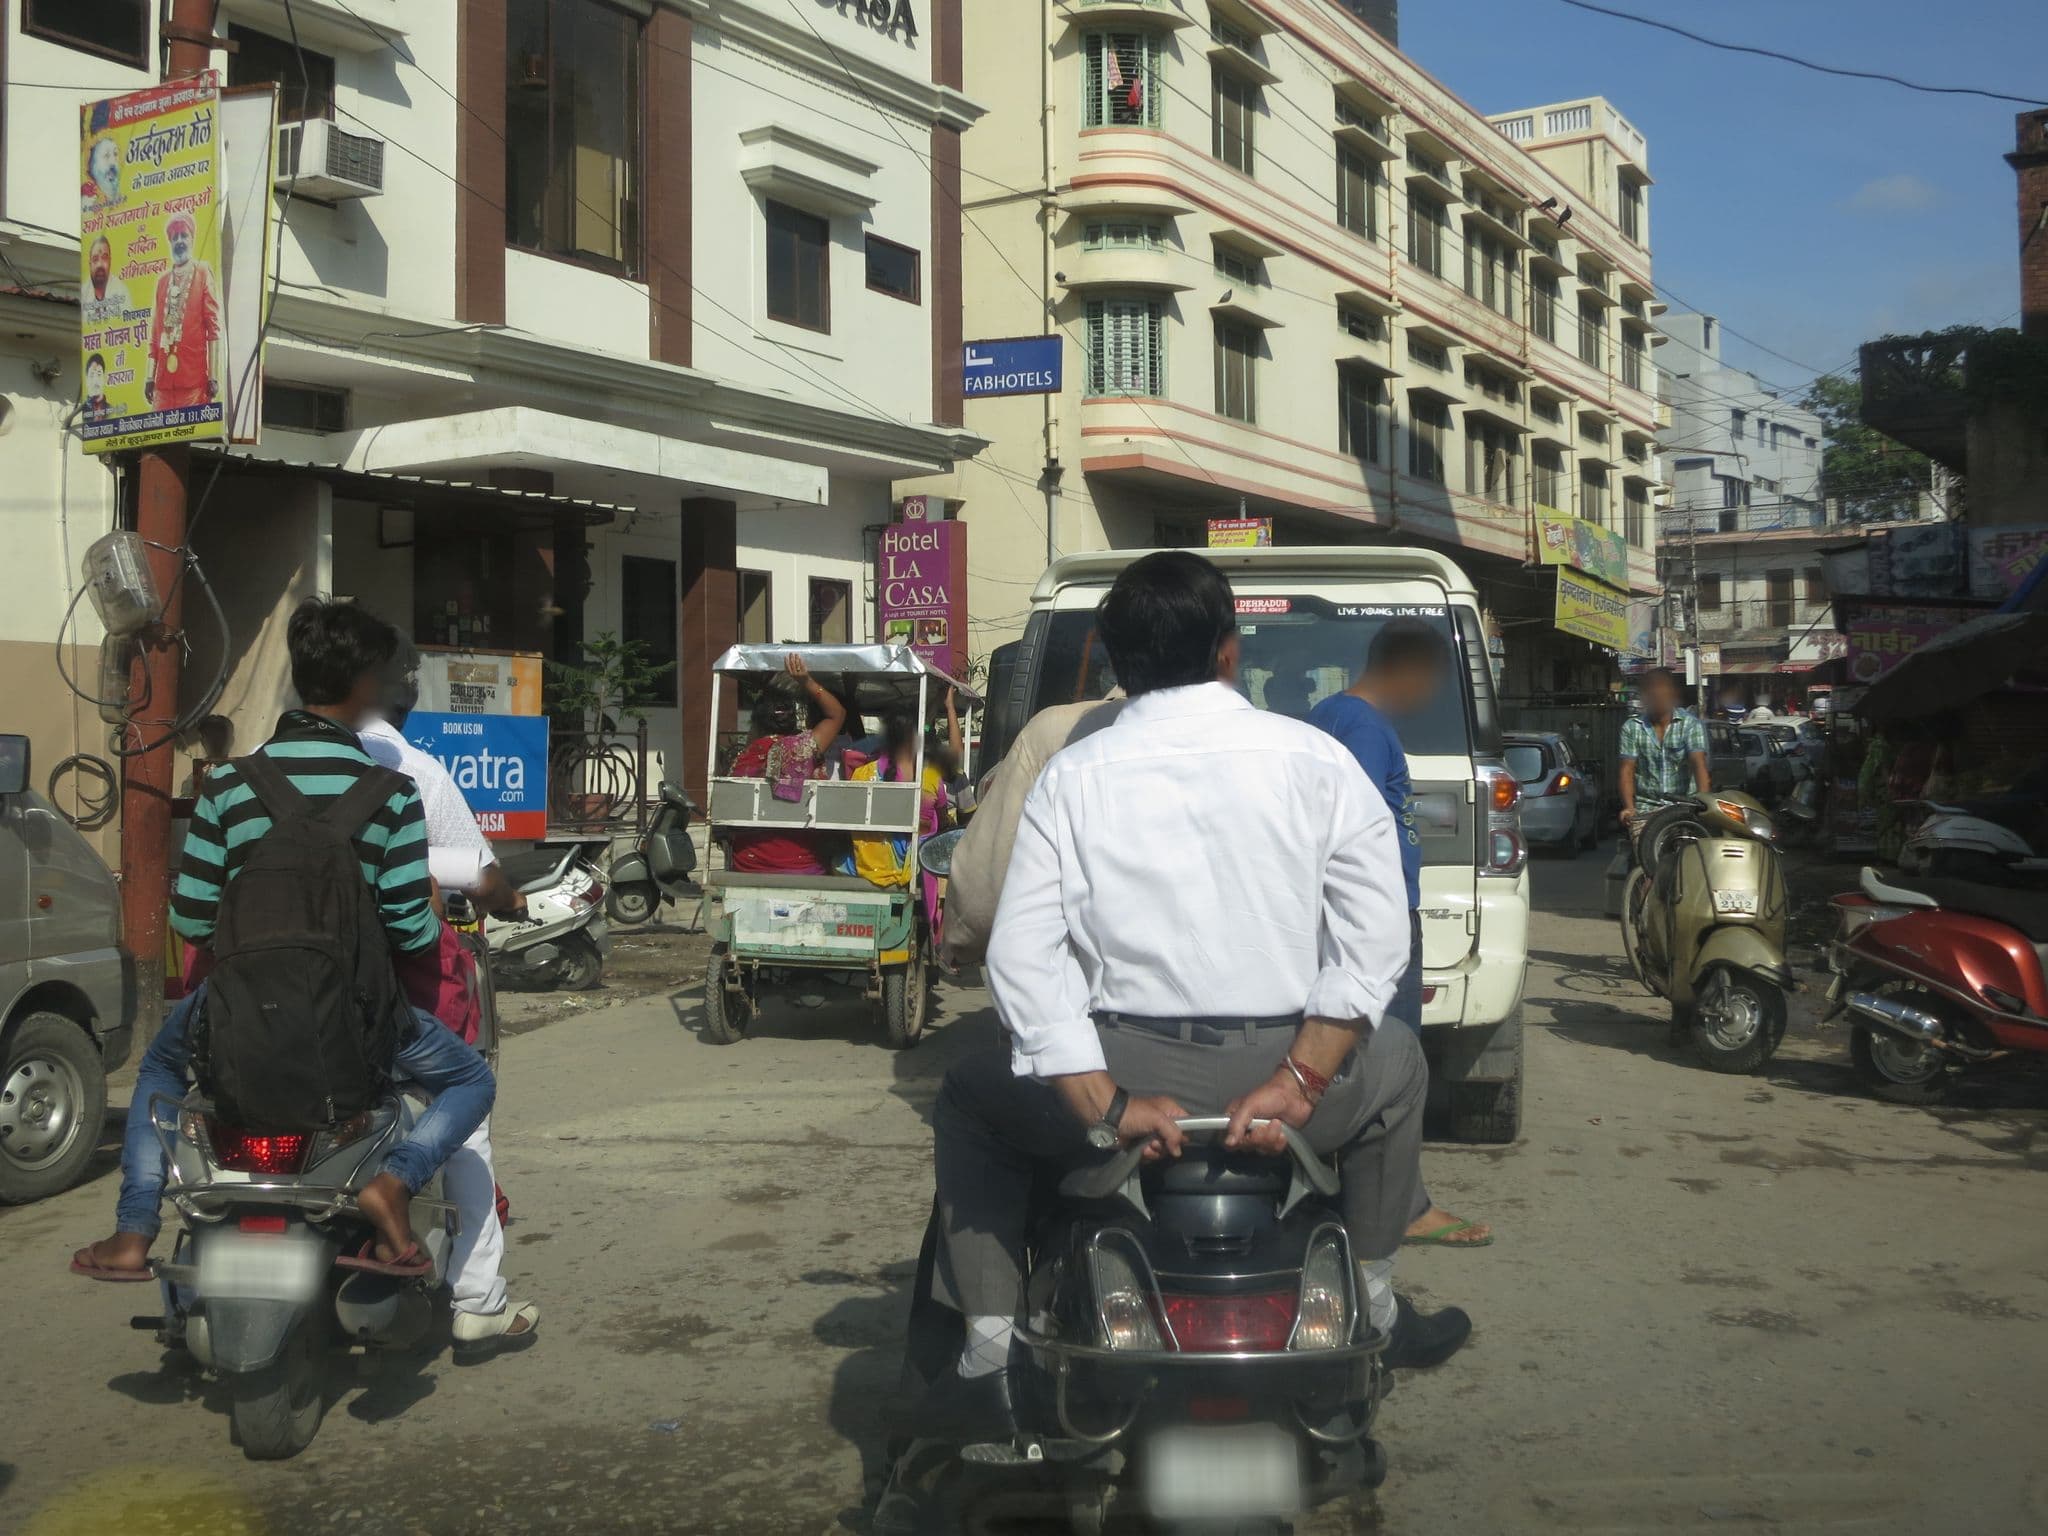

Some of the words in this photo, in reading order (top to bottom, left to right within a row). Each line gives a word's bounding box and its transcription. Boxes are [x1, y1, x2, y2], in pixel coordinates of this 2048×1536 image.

[964, 371, 1053, 391] FABHOTELS
[885, 528, 939, 553] Hotel
[887, 555, 922, 580] LA
[885, 582, 950, 607] CASA
[1338, 607, 1359, 616] LIVE
[1397, 607, 1417, 616] LIVE
[1419, 607, 1445, 616] FREE
[443, 722, 463, 735] BOOK
[464, 723, 473, 735] US
[473, 723, 483, 735] ON
[498, 790, 524, 802] .com
[1720, 900, 1752, 909] 2112
[836, 923, 874, 937] EXIDE
